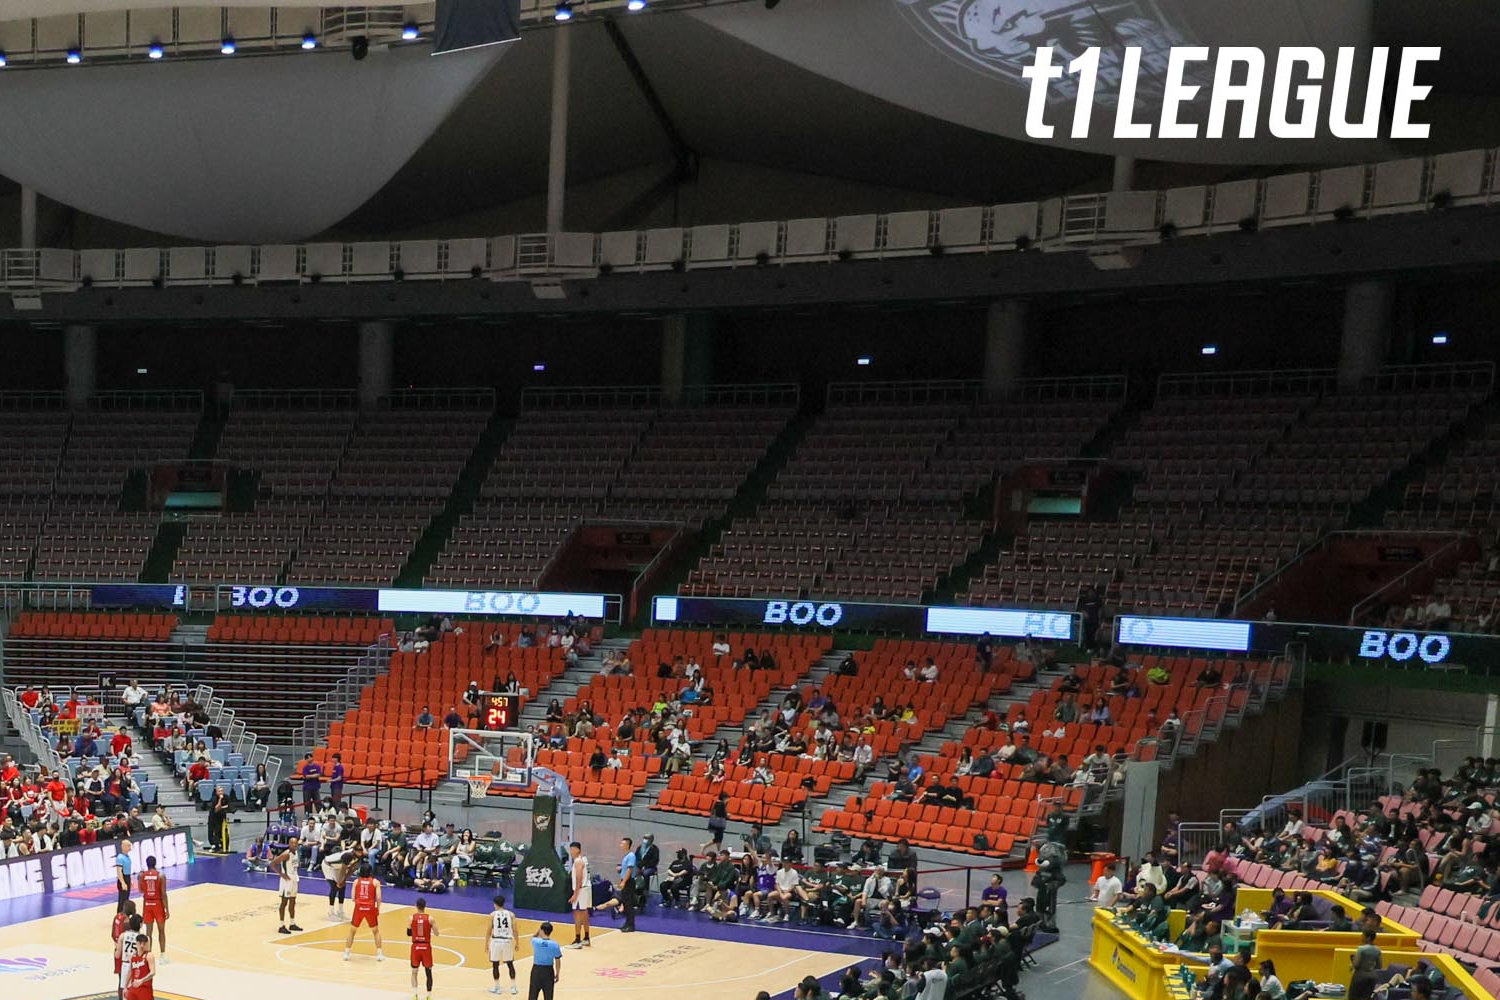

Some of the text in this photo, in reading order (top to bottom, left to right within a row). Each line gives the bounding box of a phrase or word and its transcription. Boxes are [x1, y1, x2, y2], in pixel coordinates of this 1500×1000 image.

[464, 590, 540, 613] BOO
[763, 601, 842, 626] BOO
[1358, 630, 1450, 664] BOO
[489, 709, 506, 724] 24
[51, 845, 117, 891] SOME
[497, 917, 509, 928] 14
[124, 941, 138, 953] 75
